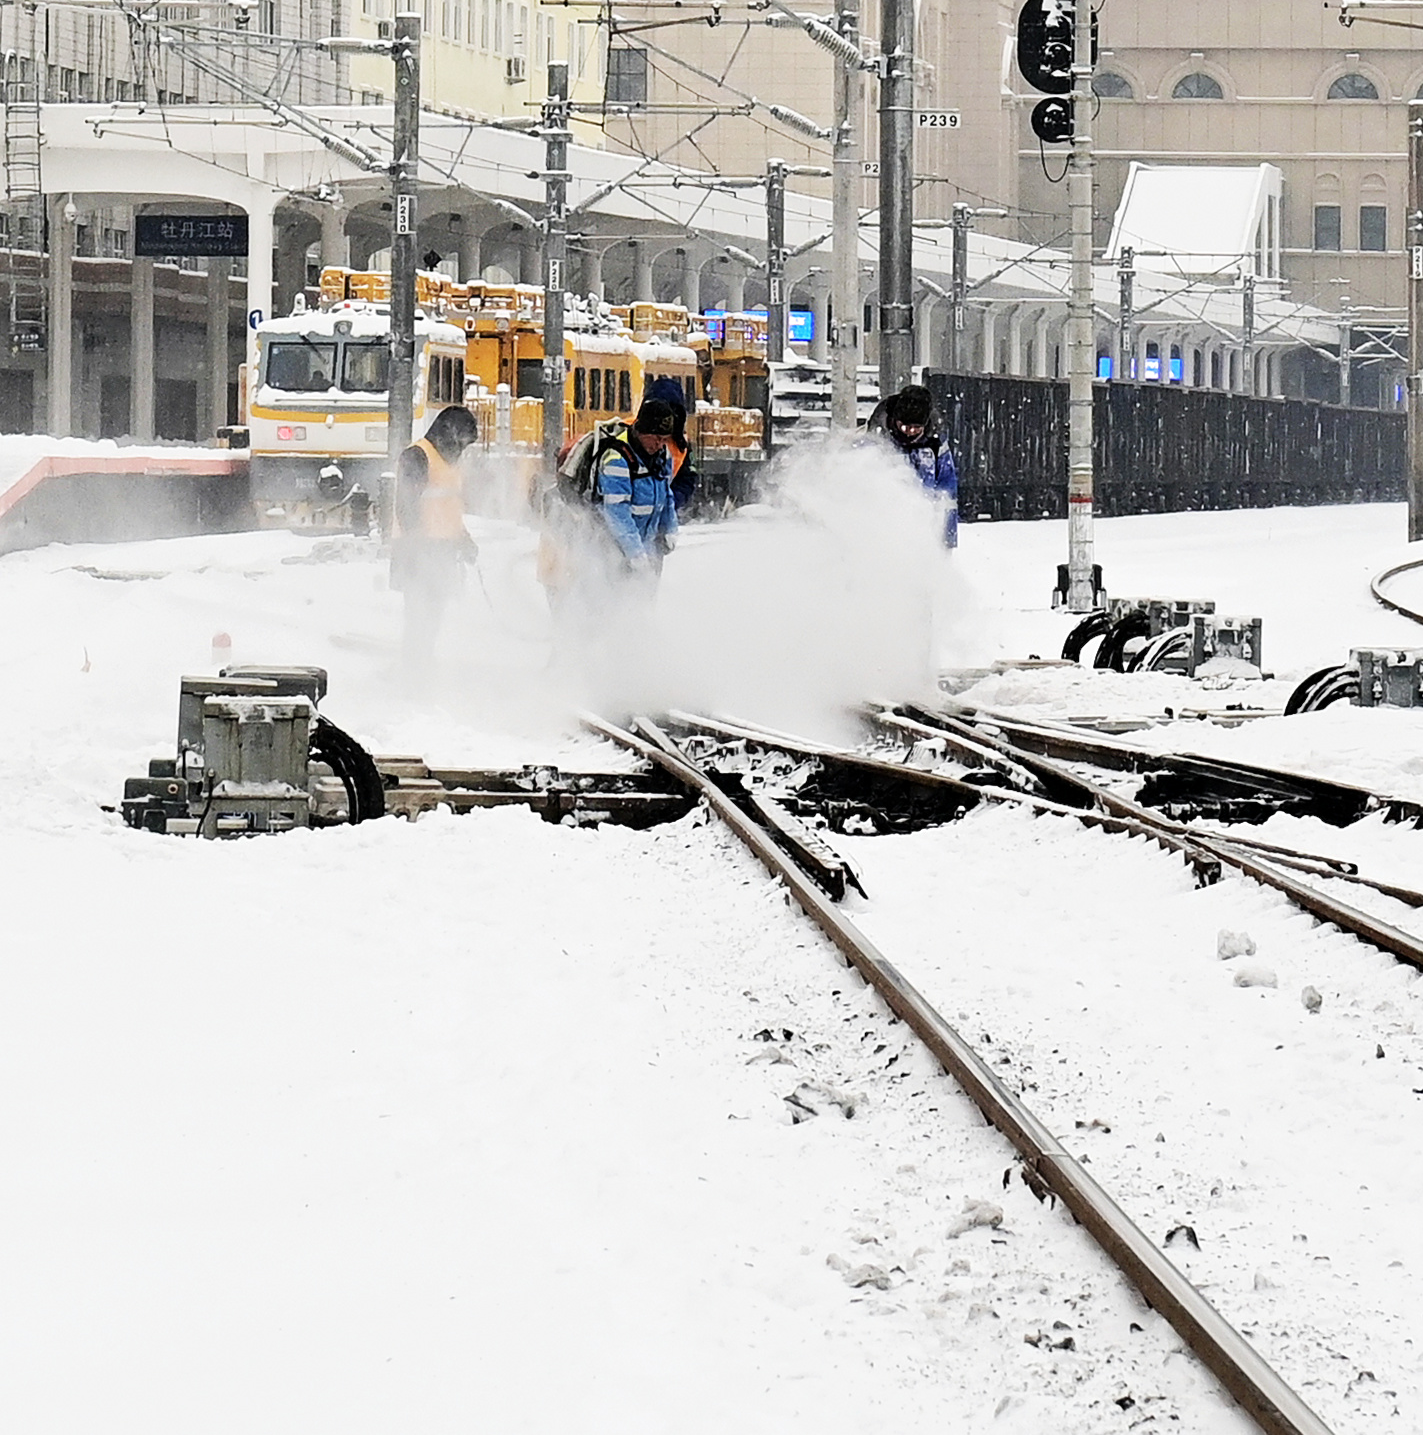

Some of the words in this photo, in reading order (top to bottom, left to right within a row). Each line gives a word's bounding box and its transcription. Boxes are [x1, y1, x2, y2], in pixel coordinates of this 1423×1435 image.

[919, 115, 958, 127] P239
[399, 196, 407, 233] P230
[161, 221, 234, 239] 牡丹江站
